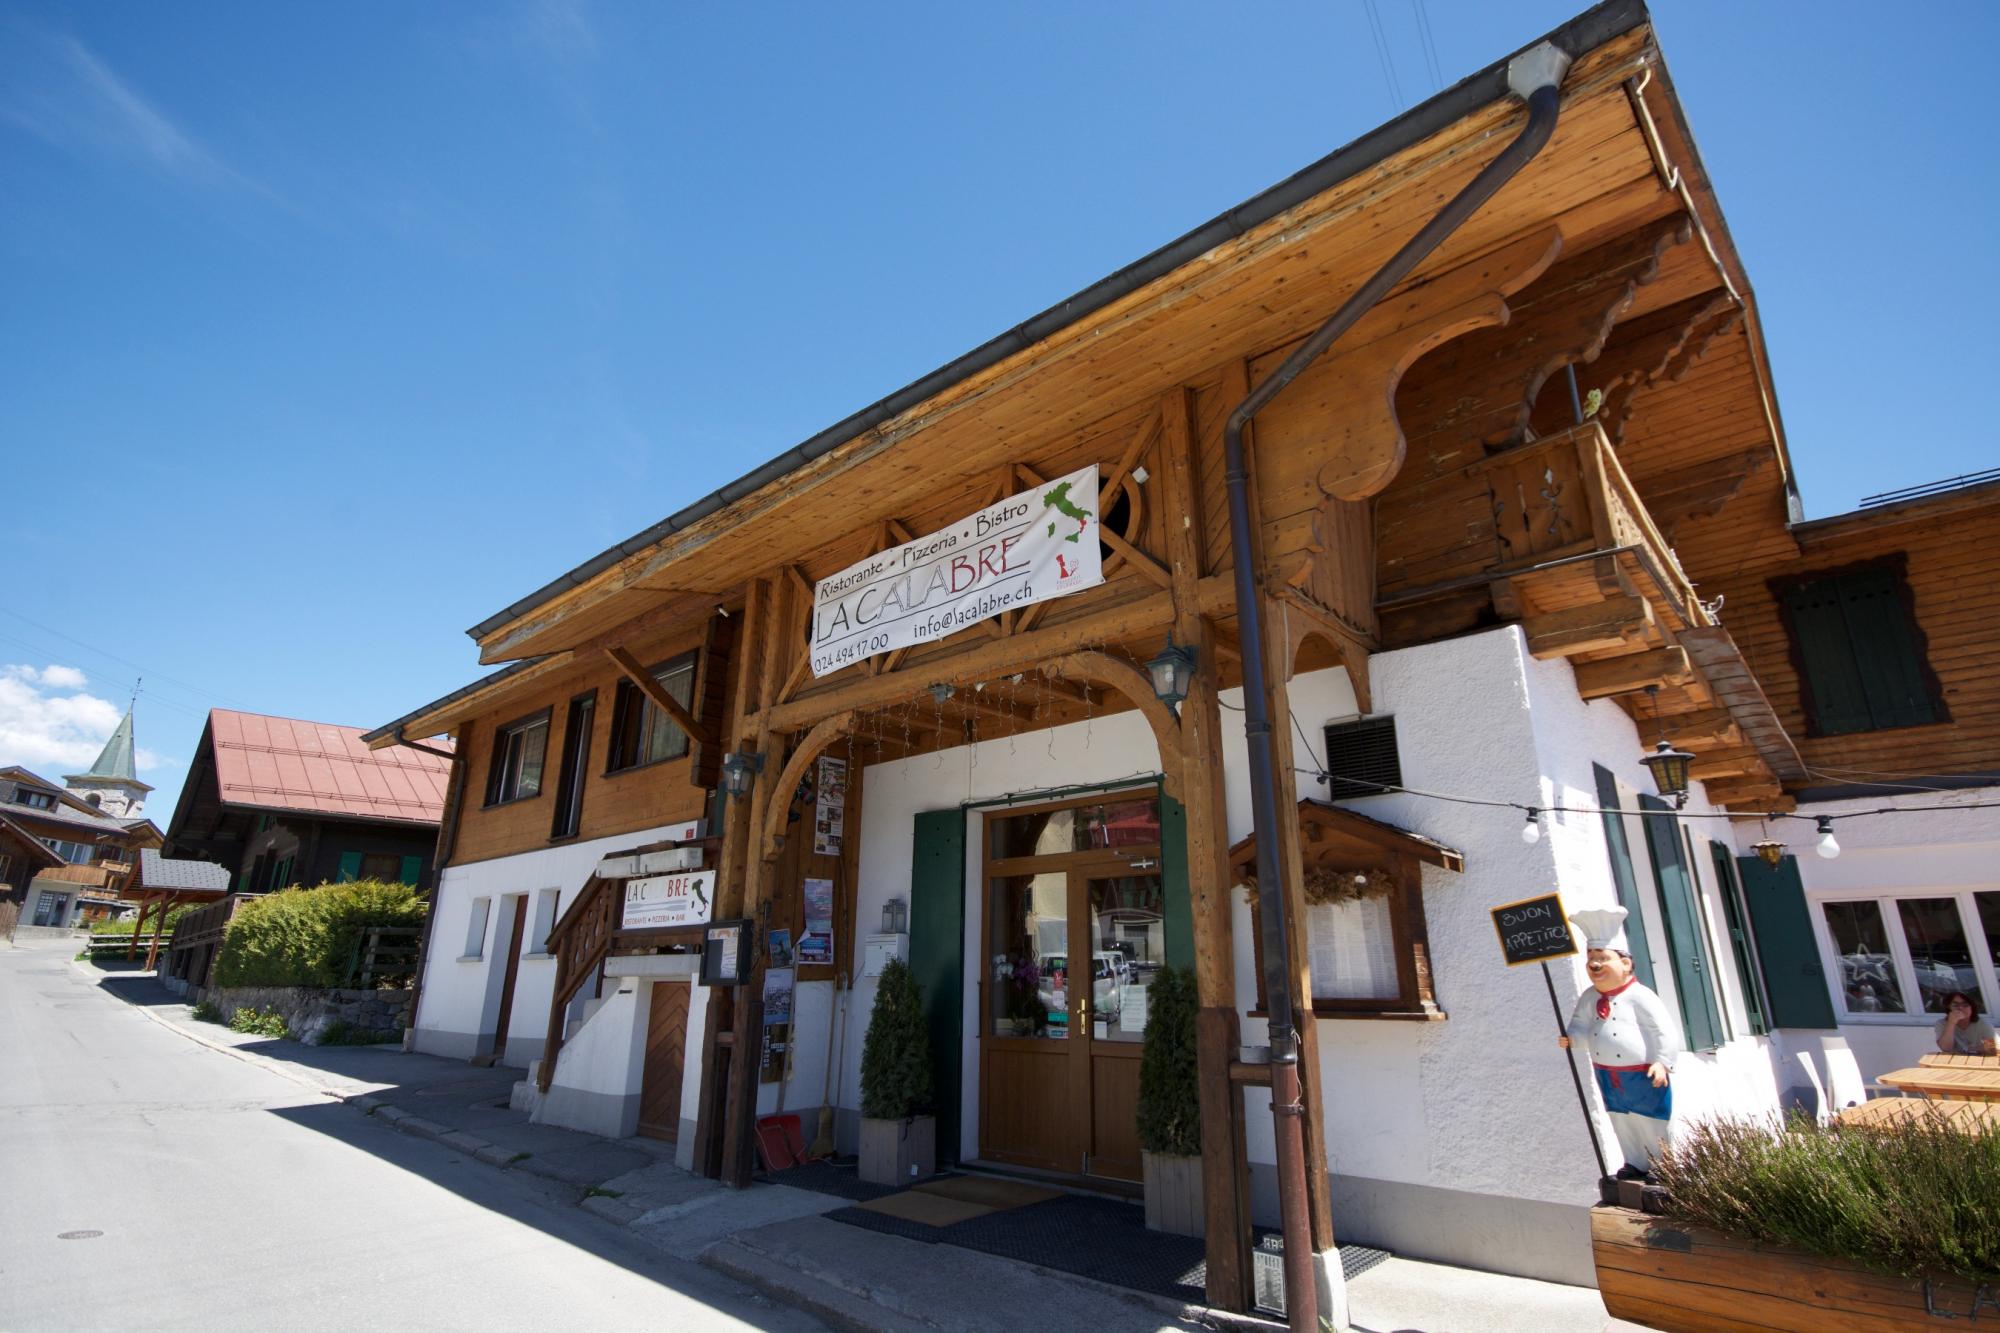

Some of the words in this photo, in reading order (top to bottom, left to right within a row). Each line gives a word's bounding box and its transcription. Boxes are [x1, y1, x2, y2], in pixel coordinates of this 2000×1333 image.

[819, 562, 884, 600] Ristorante
[902, 533, 957, 568] Pizzeria
[975, 503, 1029, 538] Bistro
[914, 580, 1032, 638] info@lacalabre.ch
[814, 656, 833, 673] 024
[835, 646, 854, 664] 494
[856, 639, 868, 656] 17
[870, 633, 889, 651] 00
[1502, 904, 1552, 927] BUON
